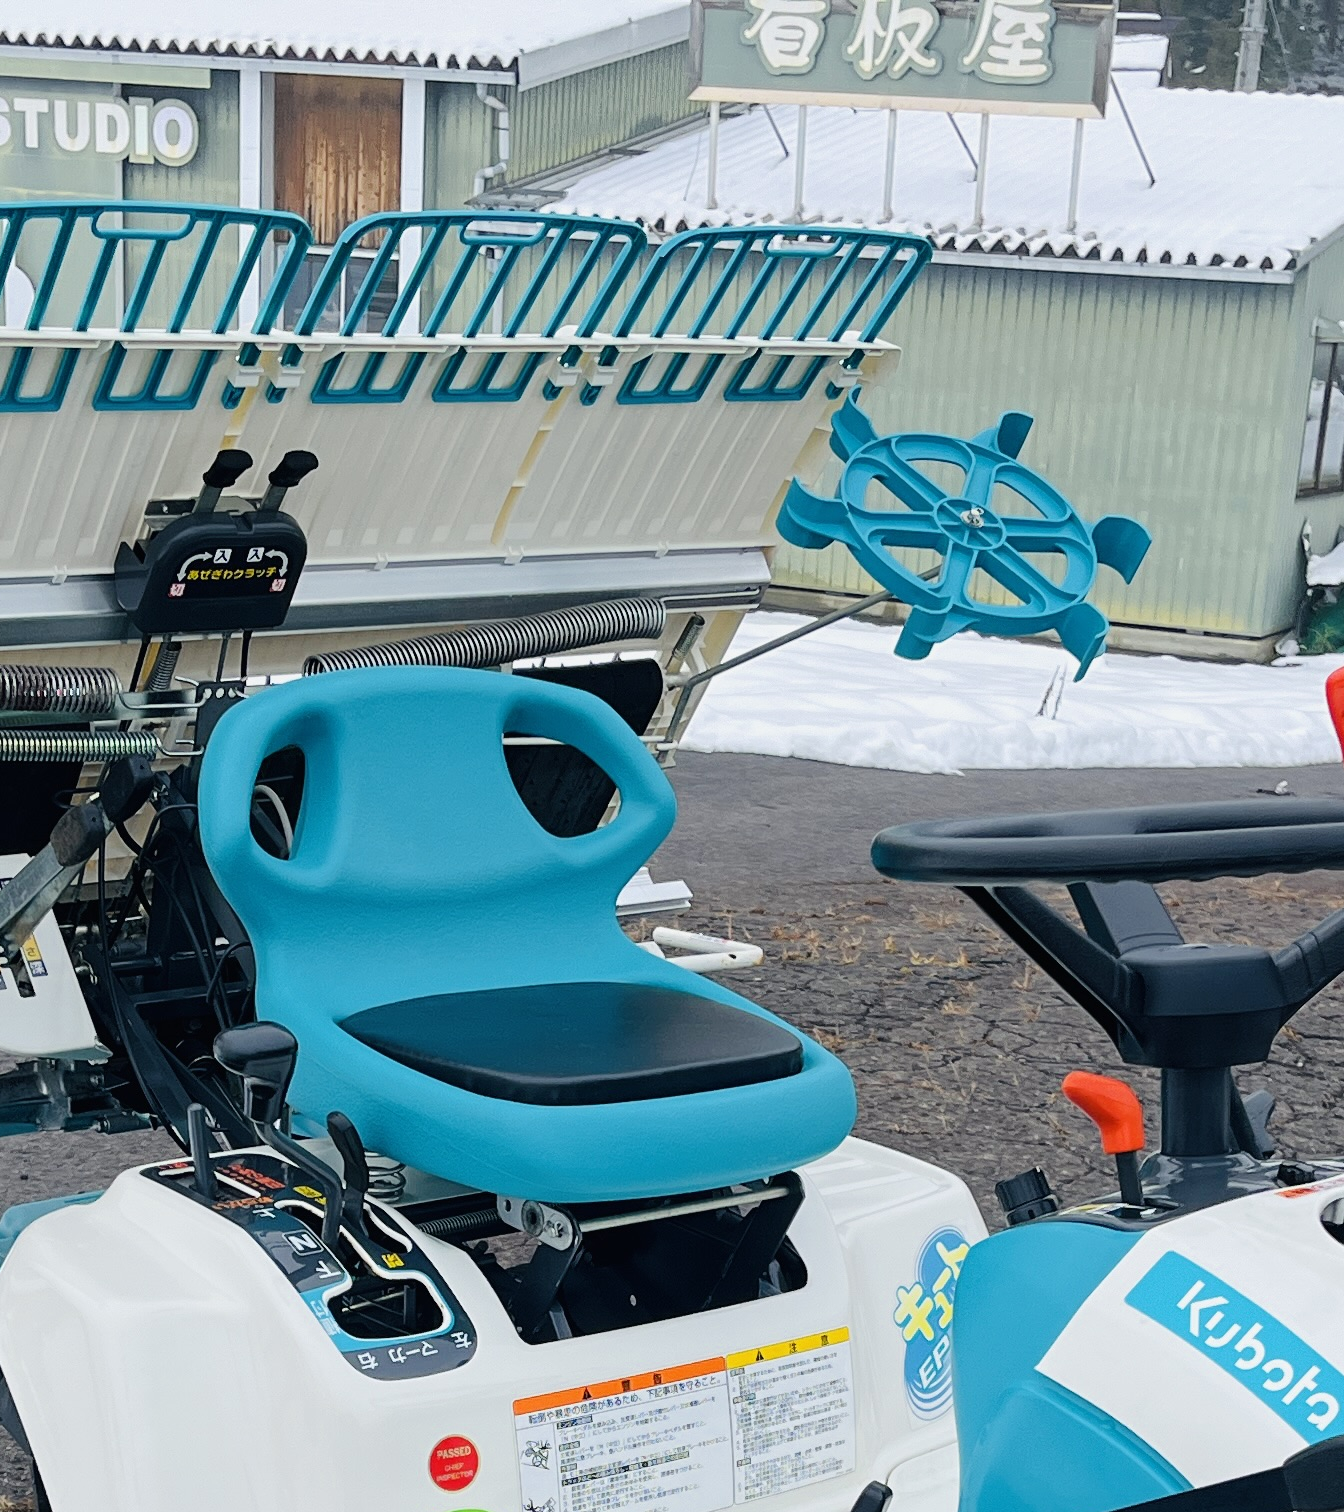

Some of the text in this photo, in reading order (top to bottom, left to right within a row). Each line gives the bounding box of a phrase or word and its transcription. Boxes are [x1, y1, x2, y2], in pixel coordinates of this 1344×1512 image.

[744, 0, 1047, 77] 看板屋
[215, 549, 228, 562] 入
[248, 549, 261, 561] 入
[186, 567, 277, 580] あぜぎわクラッチ
[288, 1233, 317, 1251] N
[451, 1331, 472, 1349] 左
[358, 1351, 379, 1370] 右
[388, 1340, 439, 1364] マーカ
[1176, 1279, 1340, 1432] Kubota
[436, 1445, 472, 1461] PASSED
